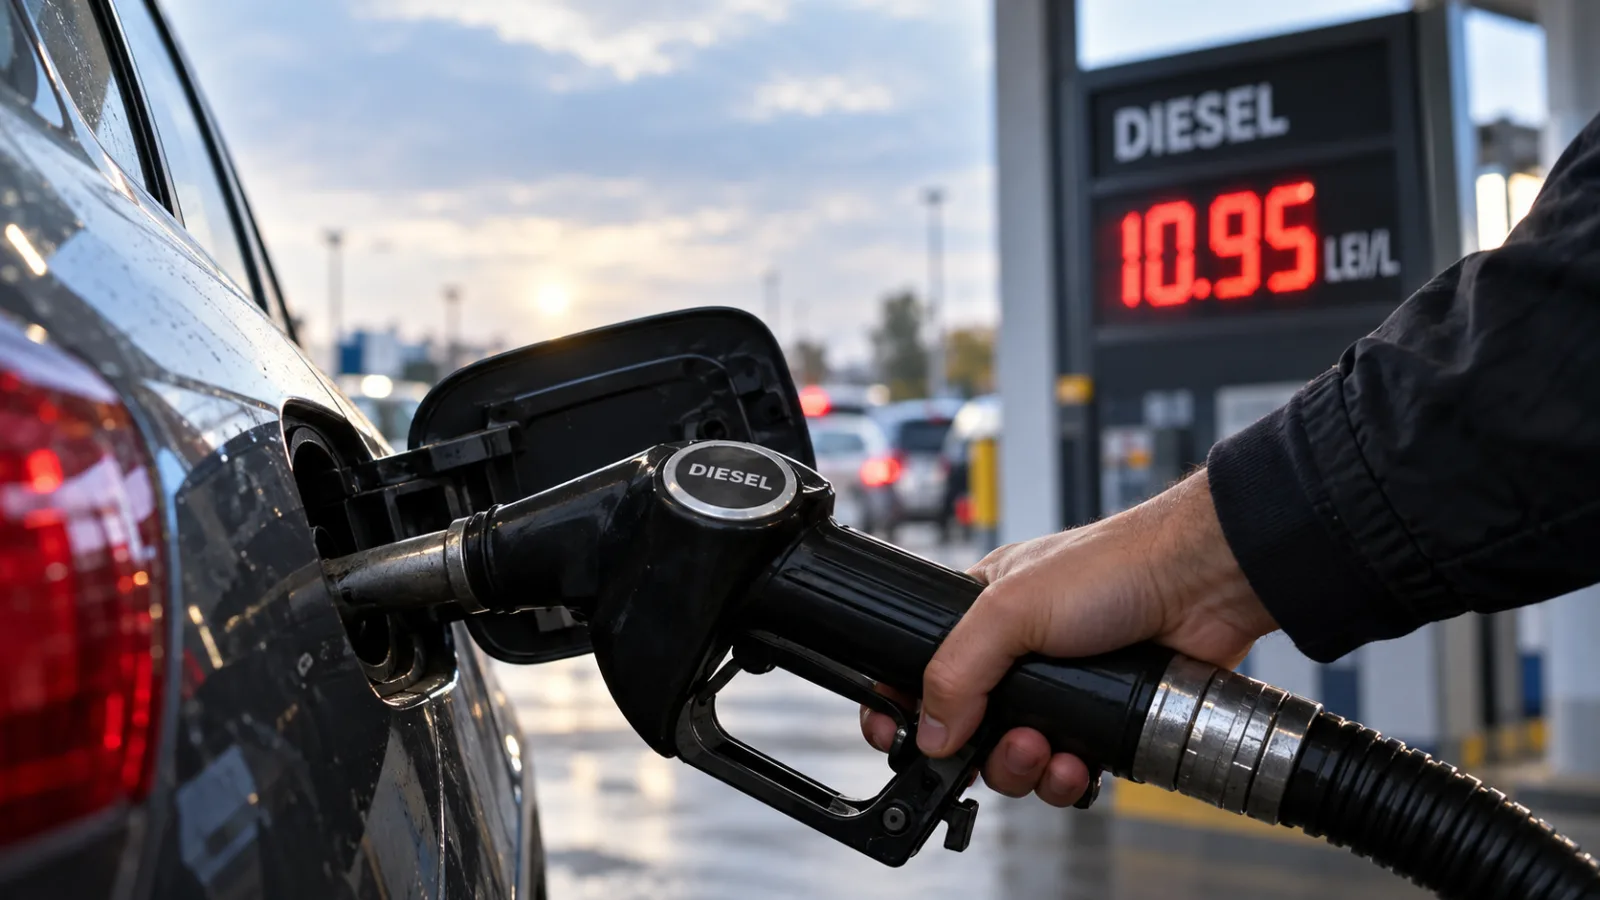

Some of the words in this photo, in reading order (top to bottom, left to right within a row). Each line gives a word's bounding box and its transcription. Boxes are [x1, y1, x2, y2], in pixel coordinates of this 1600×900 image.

[1113, 82, 1289, 163] DIESEL
[1121, 181, 1317, 308] 10.95
[1324, 229, 1400, 283] LEI/L
[688, 463, 772, 491] DIESEL
